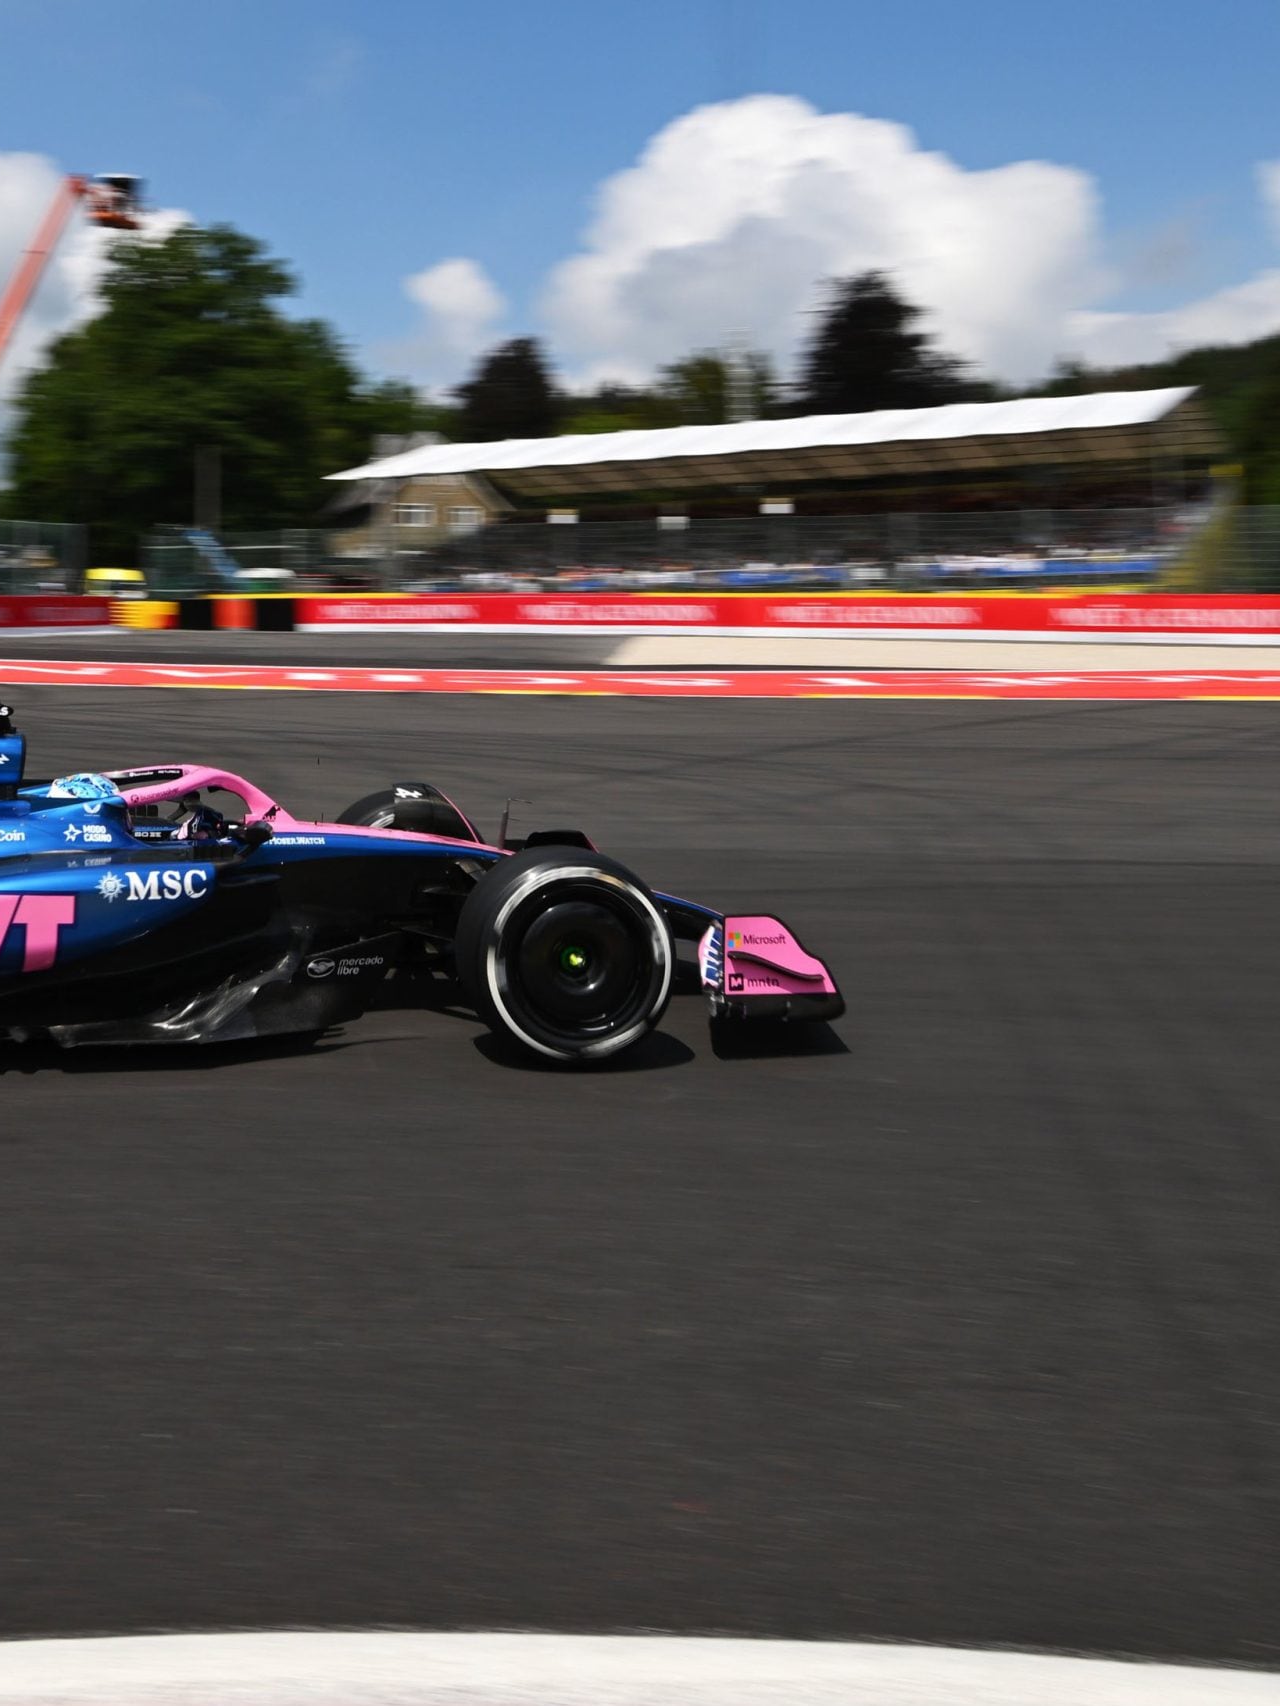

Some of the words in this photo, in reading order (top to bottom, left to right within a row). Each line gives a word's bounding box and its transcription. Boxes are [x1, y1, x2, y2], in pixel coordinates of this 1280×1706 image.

[83, 833, 112, 842] CASINO
[124, 869, 207, 900] MSC
[743, 934, 786, 944] Microsoft
[339, 956, 384, 966] mercado
[337, 965, 360, 975] libre
